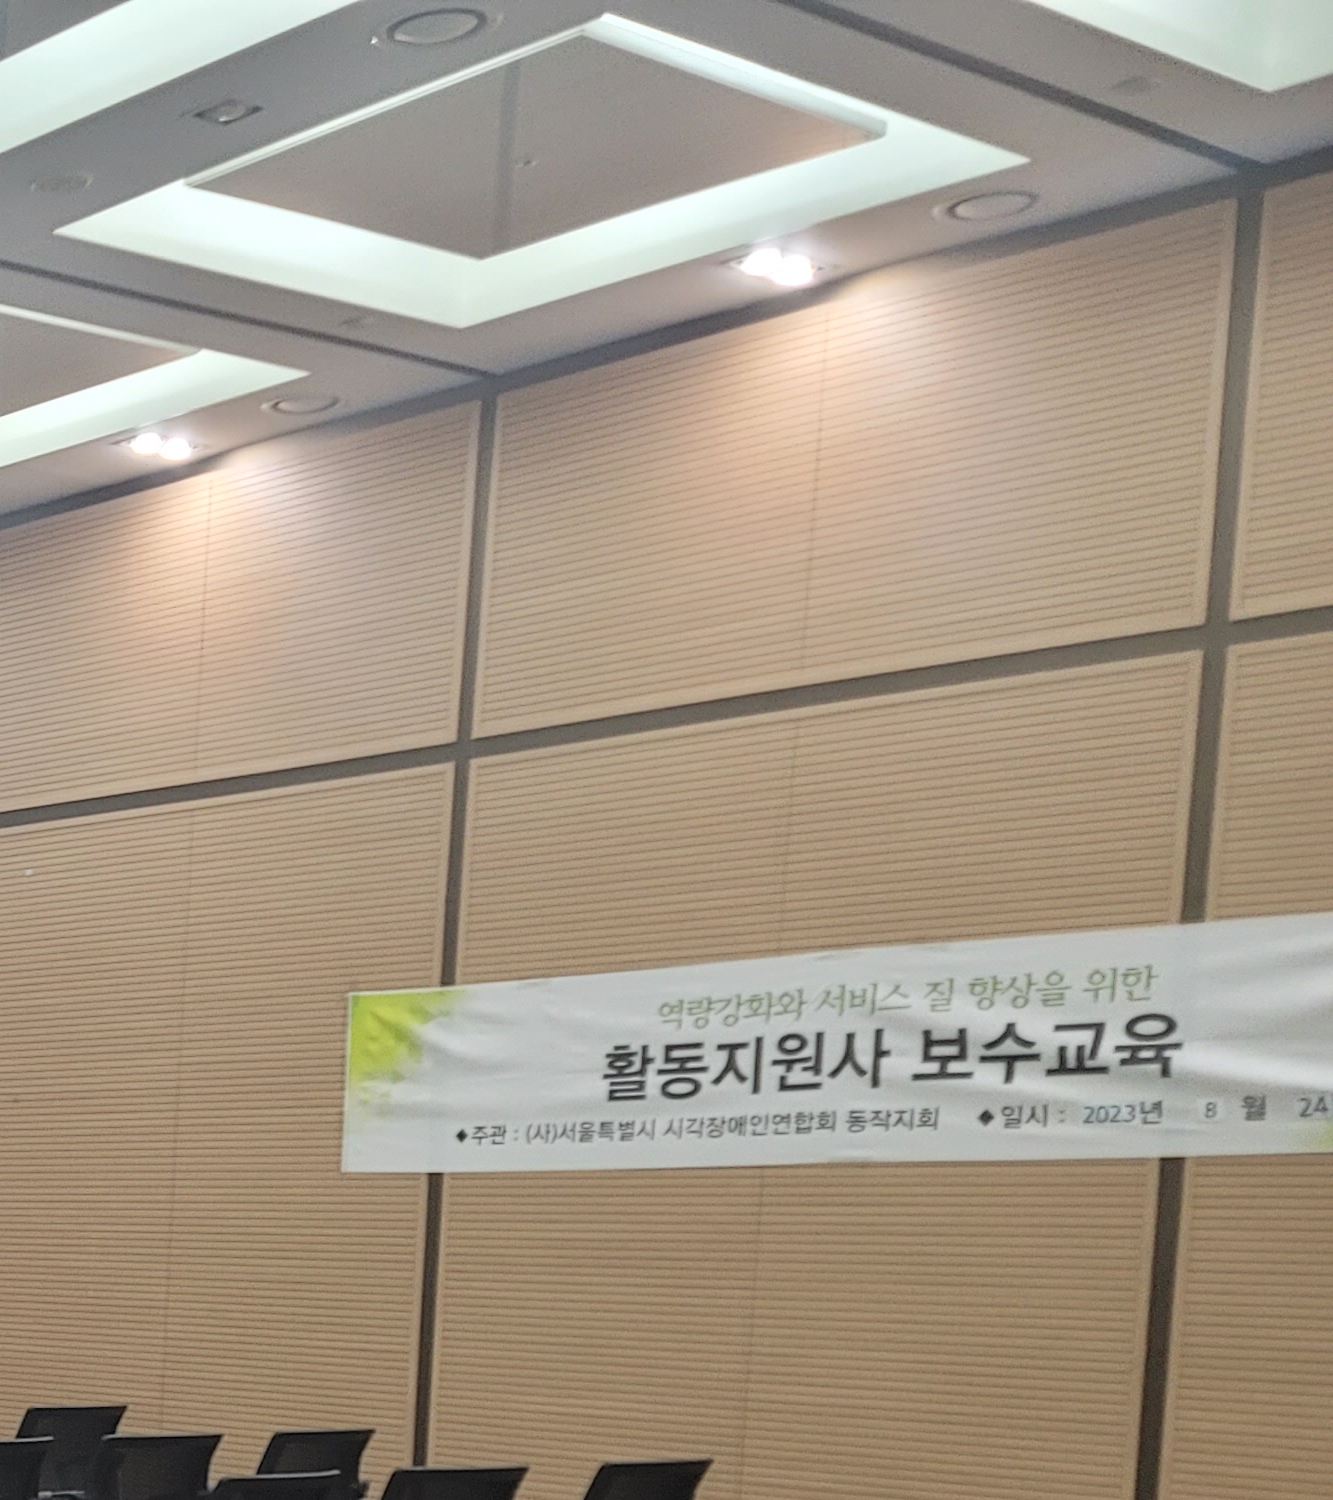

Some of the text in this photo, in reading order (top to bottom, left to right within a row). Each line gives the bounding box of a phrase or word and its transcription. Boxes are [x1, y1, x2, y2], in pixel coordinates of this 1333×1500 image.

[657, 963, 1159, 1031] 역량강화와 서비스 질 향상을 위한
[602, 1012, 1185, 1102] 활동지원사 보수교육
[525, 1118, 657, 1146] (사)서울특별시
[662, 1107, 837, 1140] 시각장애인연합회
[845, 1106, 941, 1134] 동작지회
[1001, 1103, 1049, 1130] 일시
[1083, 1100, 1164, 1126] 2023년
[1204, 1101, 1218, 1120] 8
[1241, 1094, 1267, 1122] 월
[1298, 1095, 1329, 1120] 24
